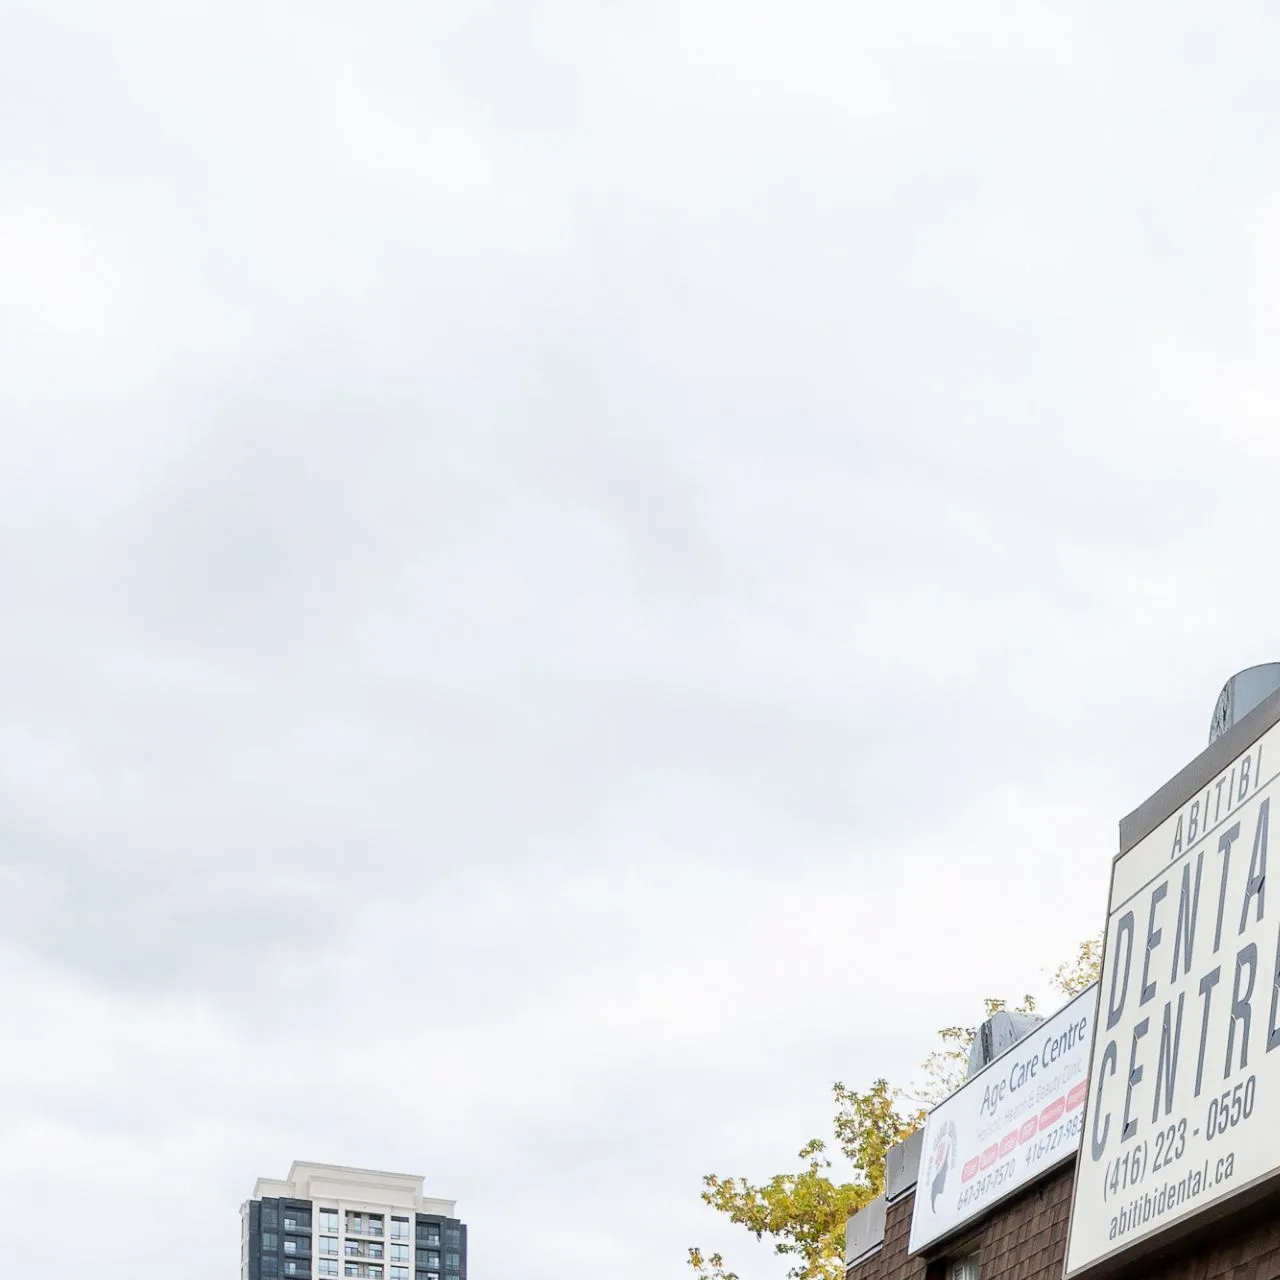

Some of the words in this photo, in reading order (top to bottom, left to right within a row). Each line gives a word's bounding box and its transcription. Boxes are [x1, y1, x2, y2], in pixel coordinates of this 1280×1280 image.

[1171, 744, 1262, 859] ABITIBI
[980, 1079, 1006, 1116] Age
[1009, 1054, 1039, 1093] Care
[1042, 1017, 1087, 1069] Centre
[1025, 1111, 1085, 1166] 416-727-983
[1103, 1140, 1149, 1202] (416)
[1152, 1117, 1187, 1173] 223
[1206, 1075, 1257, 1142] 0550
[1109, 1152, 1236, 1241] abitibidental.ca
